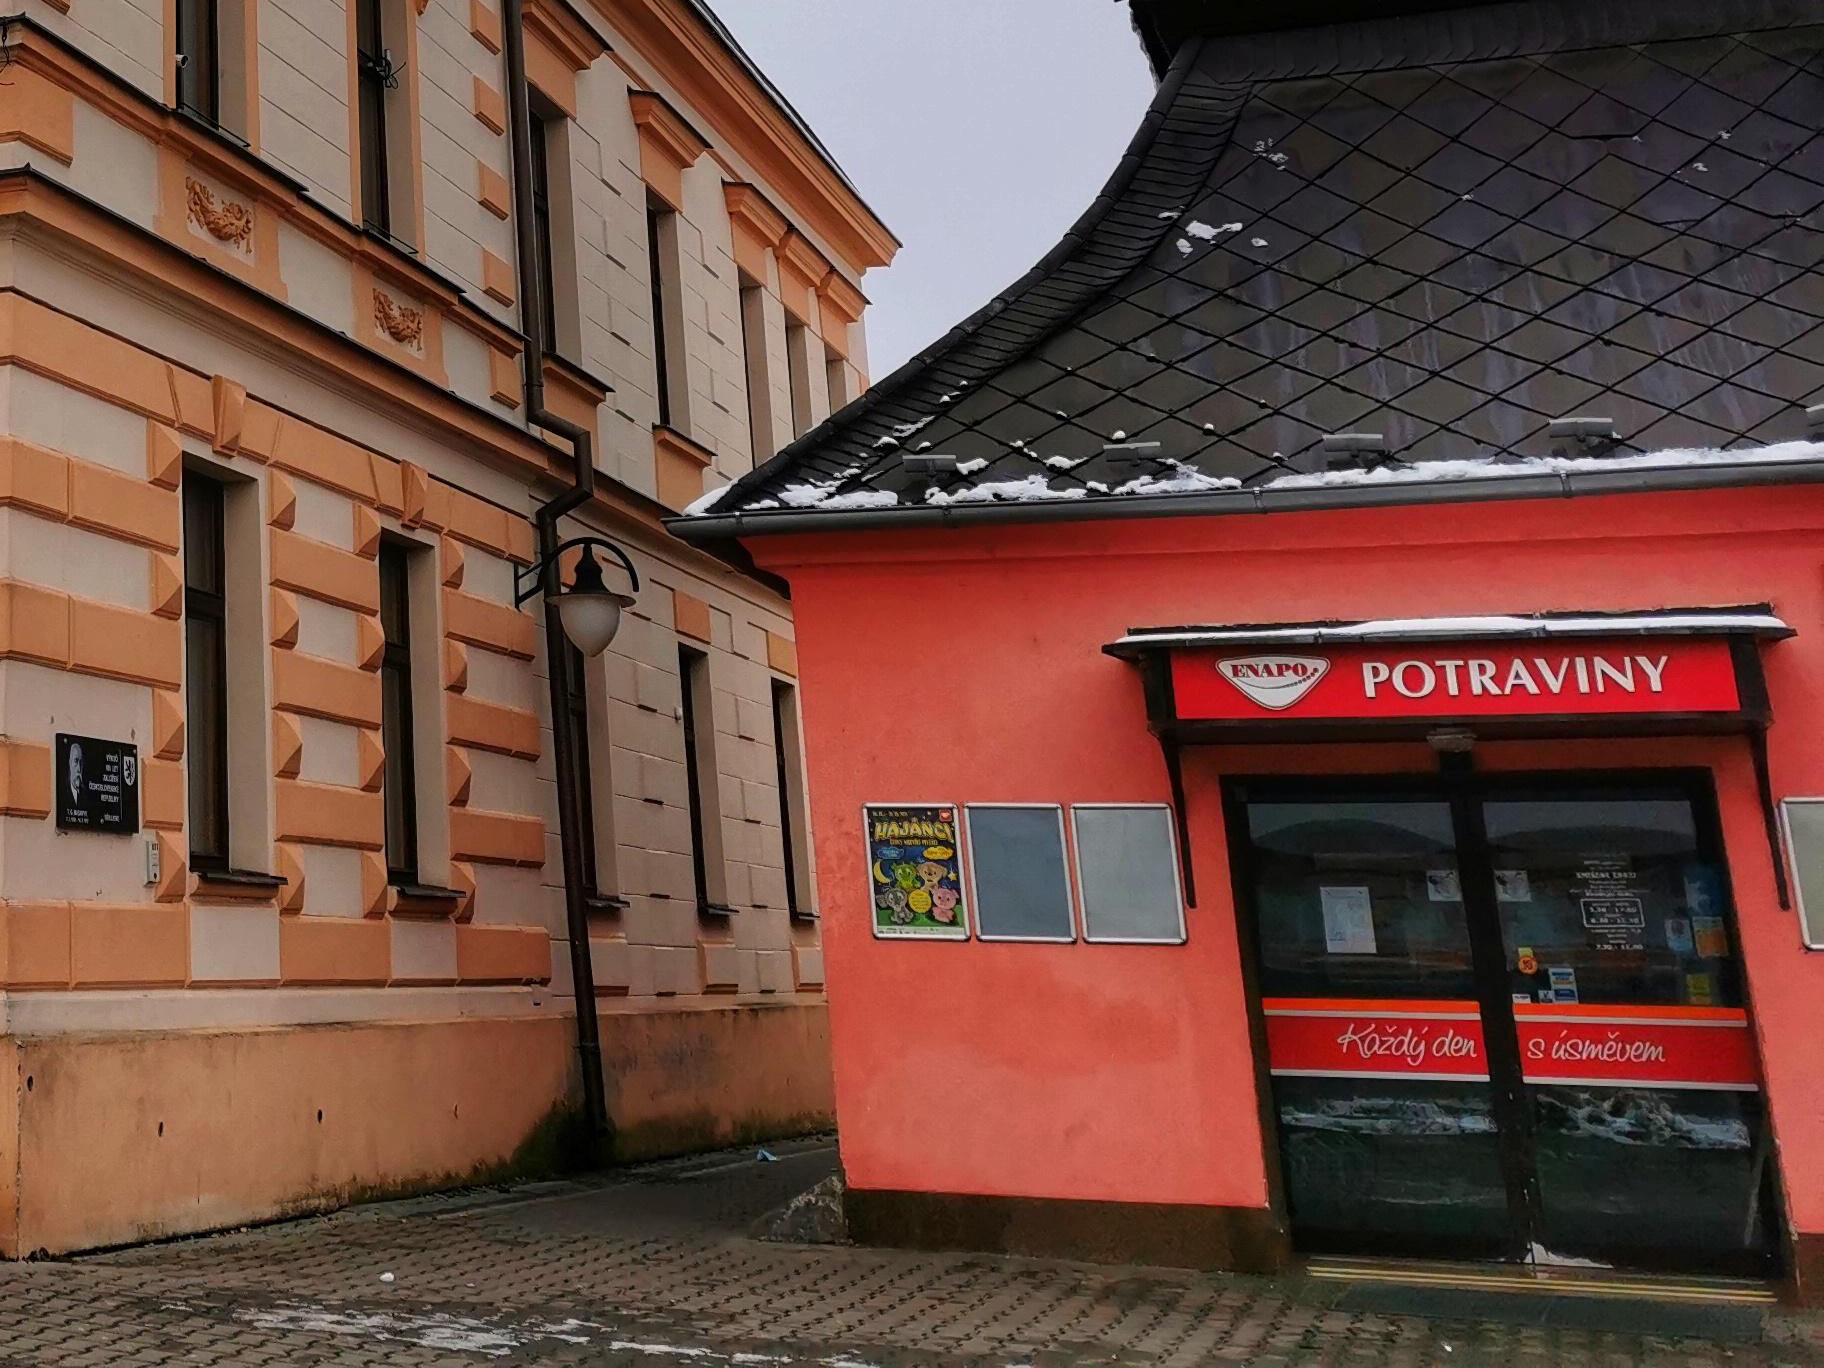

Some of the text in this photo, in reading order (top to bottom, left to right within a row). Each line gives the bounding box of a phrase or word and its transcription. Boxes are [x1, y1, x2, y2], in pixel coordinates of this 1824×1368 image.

[1230, 655, 1669, 699] ENAPO POTRAVINY
[1337, 1023, 1477, 1066] Každý den
[1527, 1030, 1666, 1062] s úsměvem
